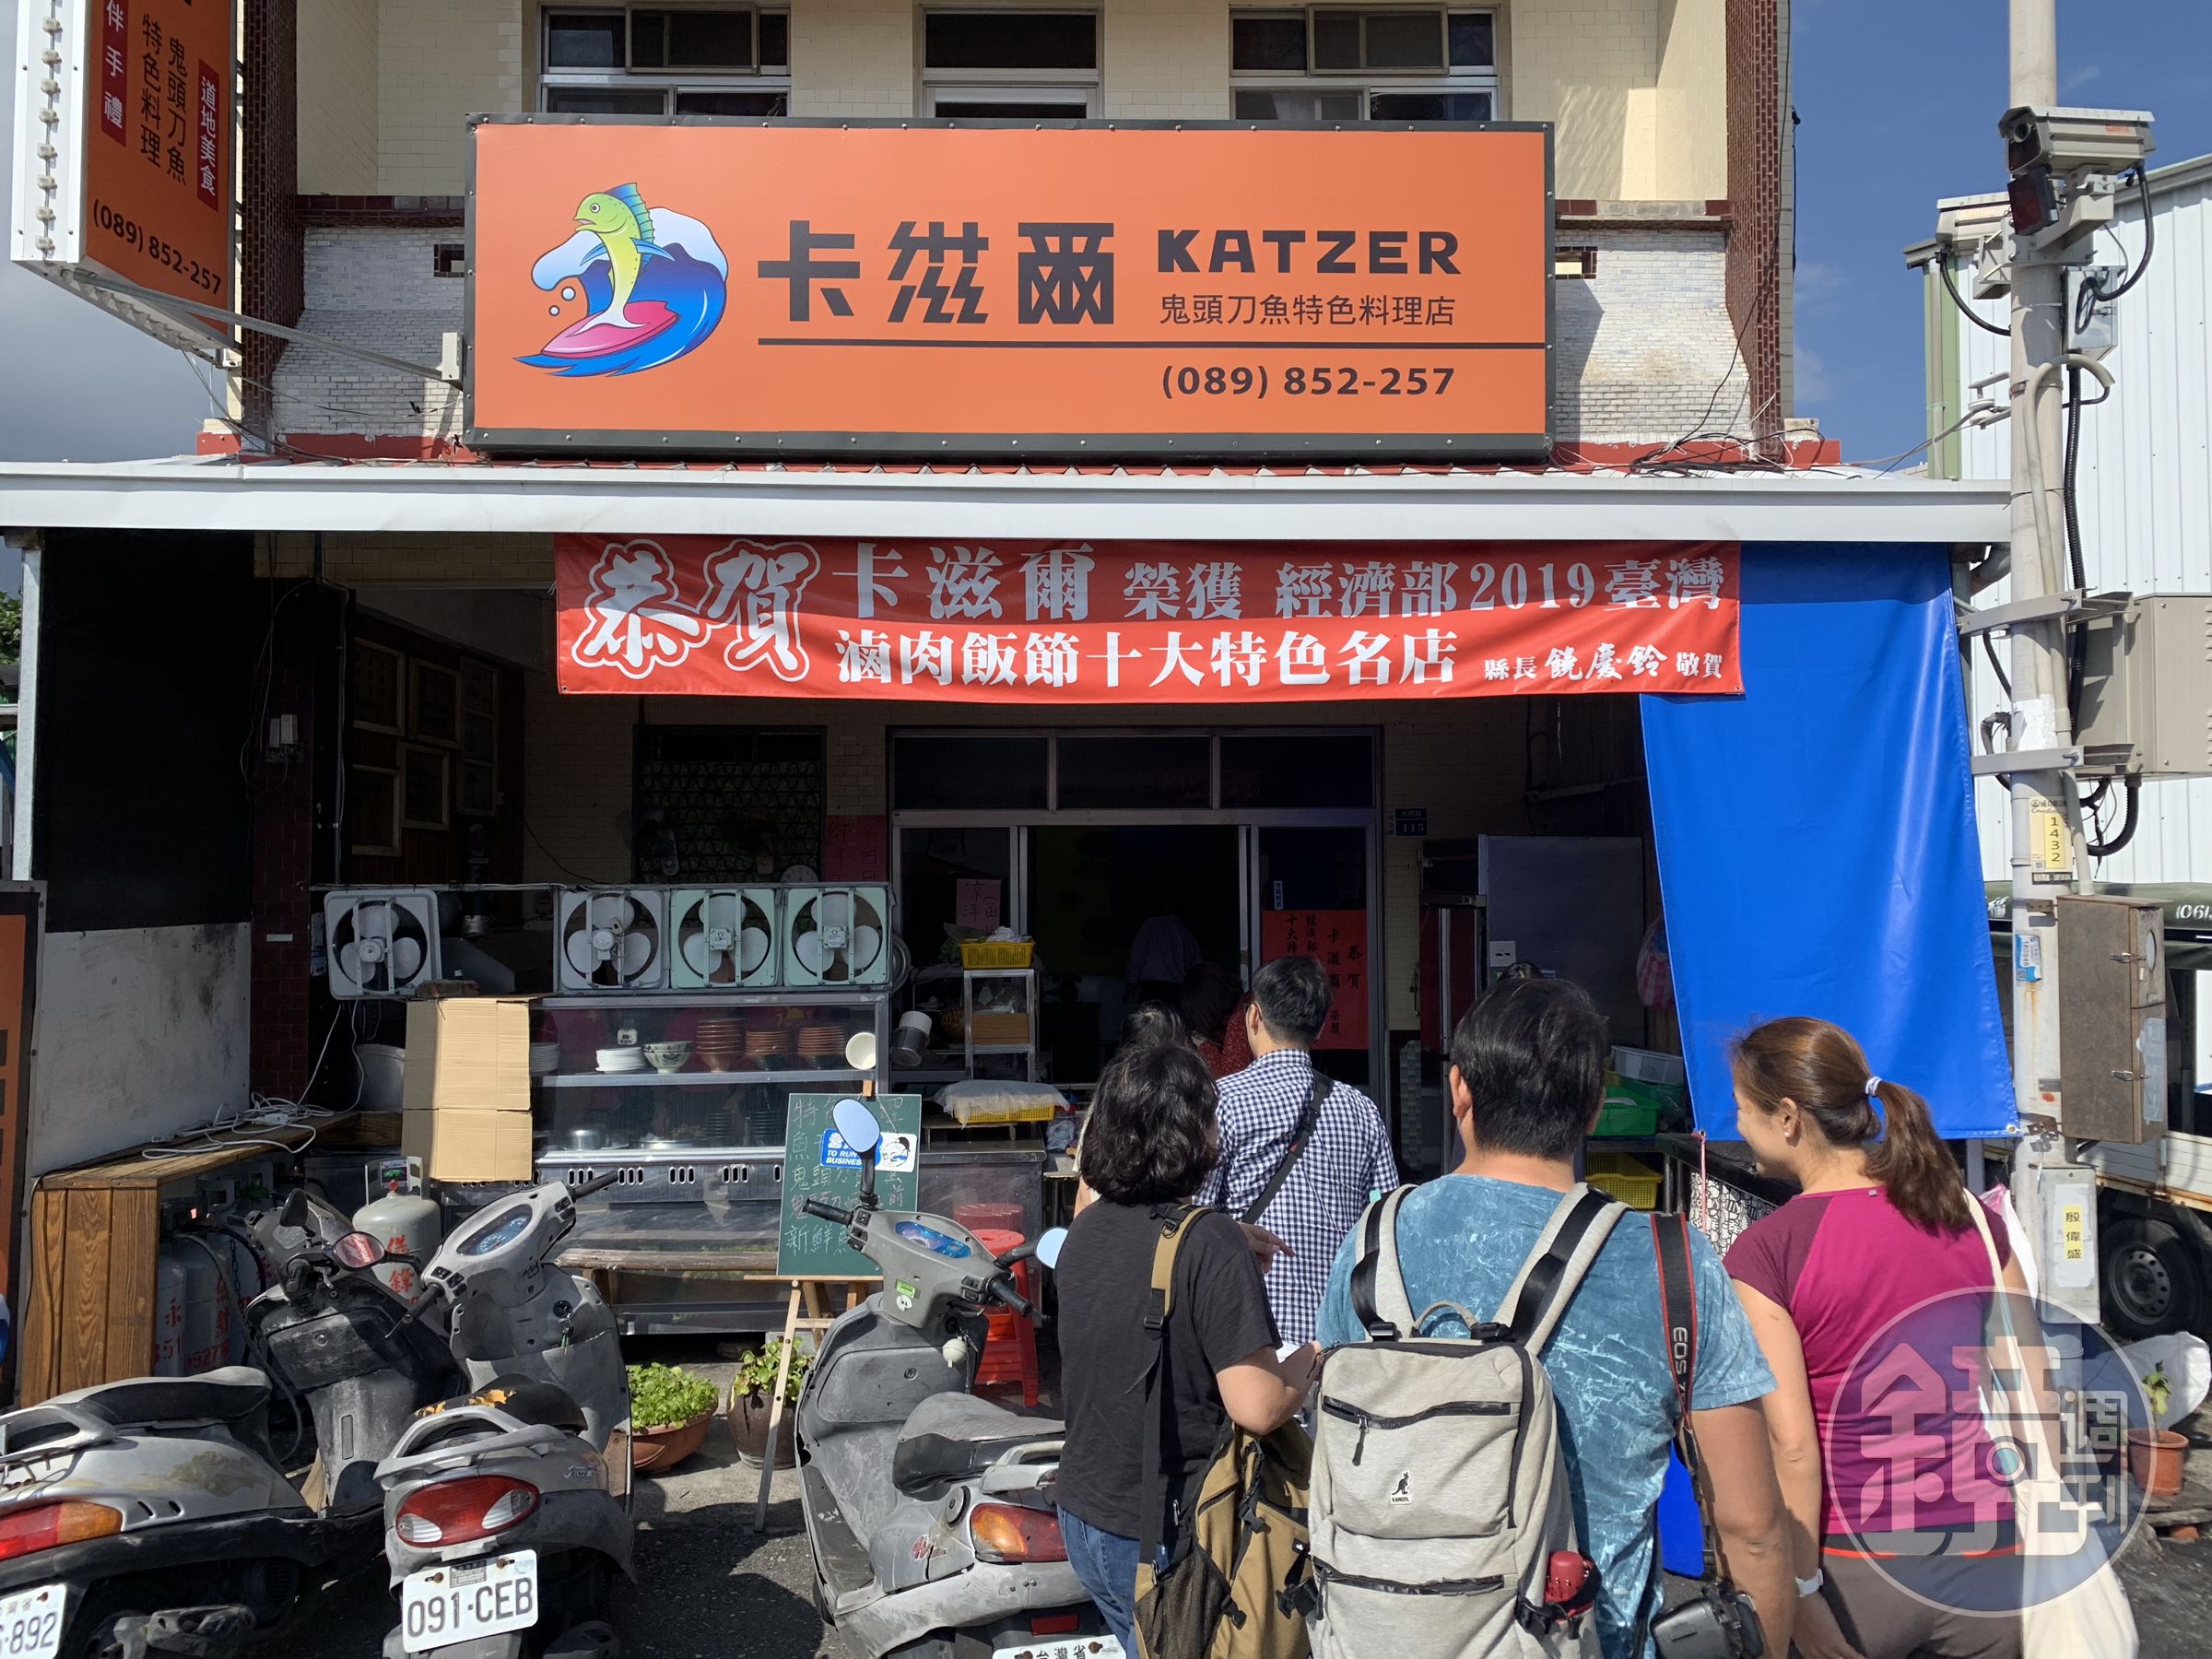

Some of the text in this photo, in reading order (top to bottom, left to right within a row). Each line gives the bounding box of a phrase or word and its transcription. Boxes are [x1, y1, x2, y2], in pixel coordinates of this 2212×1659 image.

[103, 0, 124, 130] 伴手禮
[140, 13, 162, 169] 特色料理
[167, 37, 188, 184] 鬼頭刀魚
[200, 76, 218, 197] 道地美食
[93, 199, 222, 295] (089) 852-257
[758, 220, 1114, 324] 卡滋爾
[1158, 229, 1462, 275] KATZER
[1159, 294, 1456, 326] 鬼頭刀魚特色料理店
[1162, 366, 1455, 399] (089) 852-257
[581, 547, 813, 674] 恭賀
[832, 542, 1096, 620] 卡滋爾
[1124, 560, 1242, 621] 榮獲
[834, 629, 1458, 688] 滷肉飯節十大特色名店
[1484, 657, 1538, 682] 縣長
[1676, 651, 1724, 680] 敬賀
[2050, 817, 2061, 862] 1432
[840, 1150, 857, 1159] RUN
[1673, 1326, 1688, 1375] EOS
[406, 1576, 533, 1638] 091-CEB
